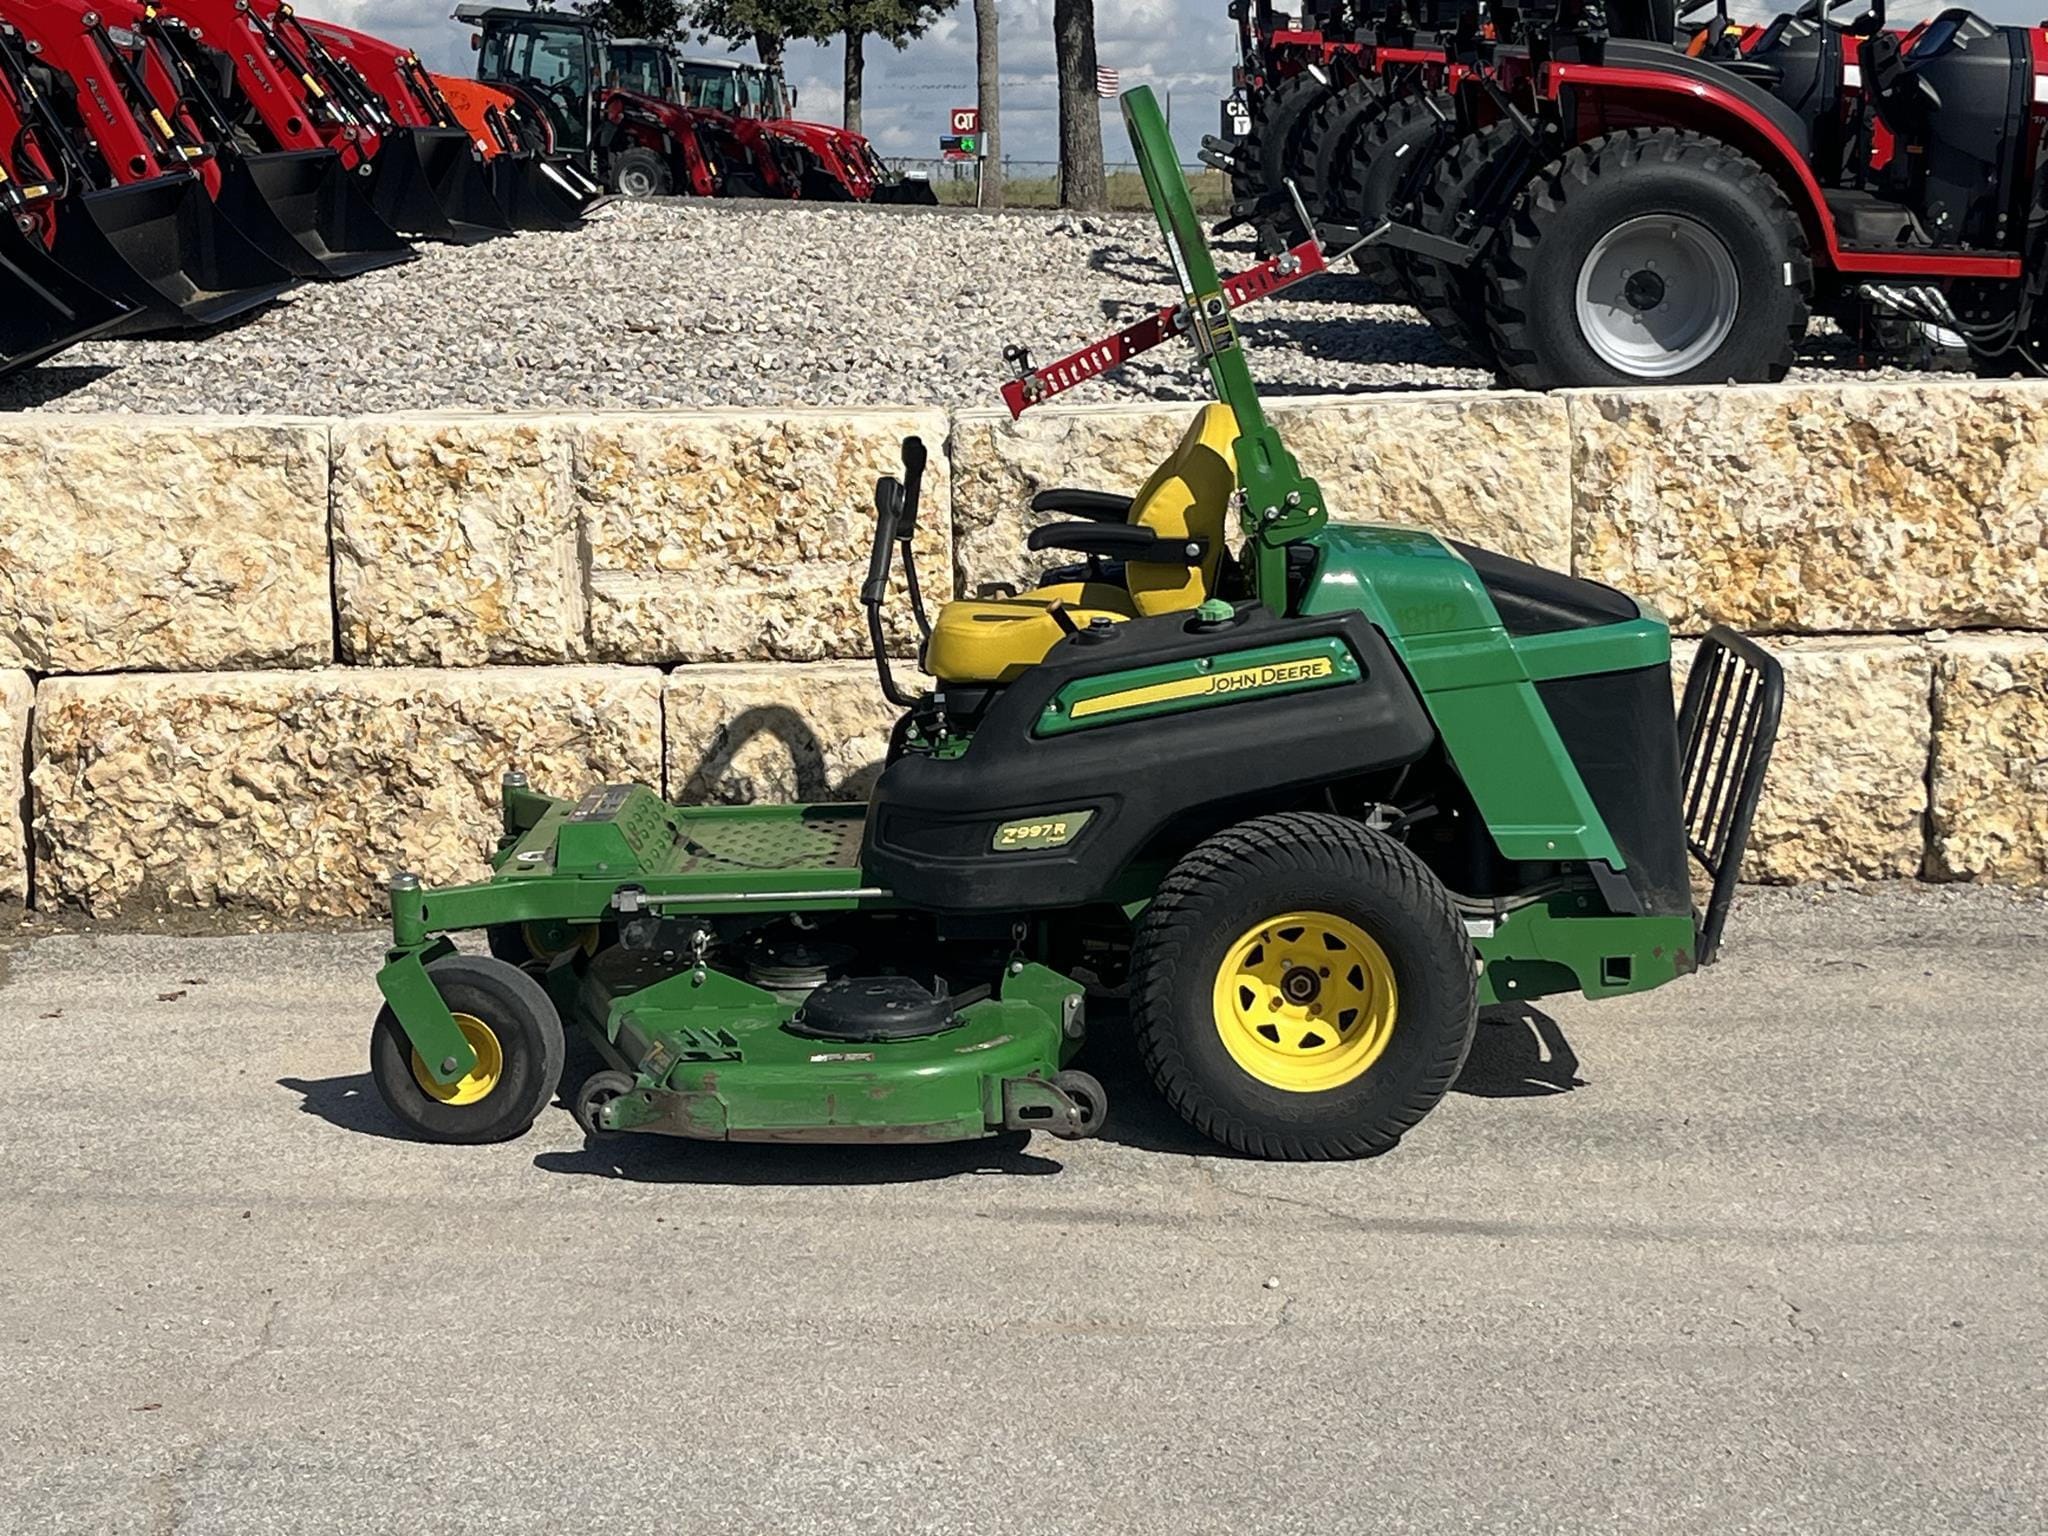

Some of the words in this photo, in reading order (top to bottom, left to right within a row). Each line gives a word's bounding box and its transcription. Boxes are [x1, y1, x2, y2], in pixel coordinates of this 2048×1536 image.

[954, 112, 976, 131] QT
[1204, 672, 1257, 693] JOHN
[1261, 662, 1323, 684] DEERE
[1001, 823, 1067, 844] Z997R
